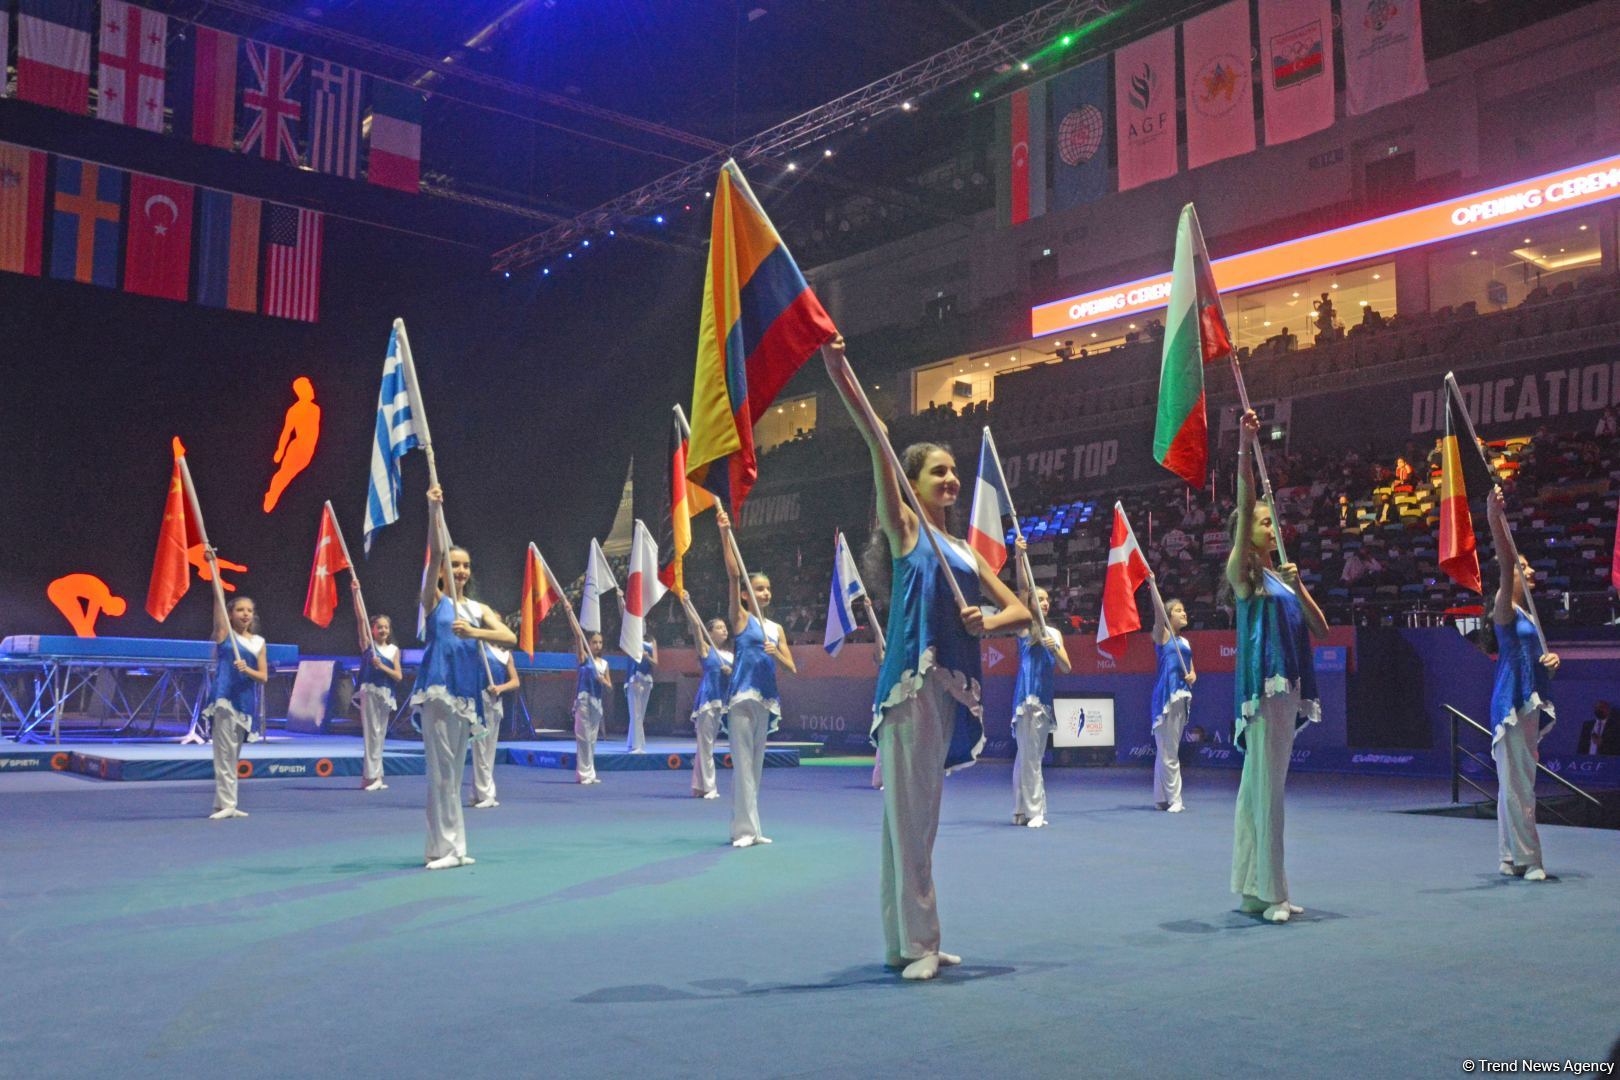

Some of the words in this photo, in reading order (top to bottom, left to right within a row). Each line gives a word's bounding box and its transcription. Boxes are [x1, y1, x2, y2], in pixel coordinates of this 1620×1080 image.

[1451, 189, 1542, 225] OPENING
[1069, 293, 1126, 320] OPENING
[1072, 439, 1119, 481] TOP
[800, 714, 846, 732] TOKIO
[278, 764, 306, 774] SPIETH
[1567, 761, 1608, 771] AGF
